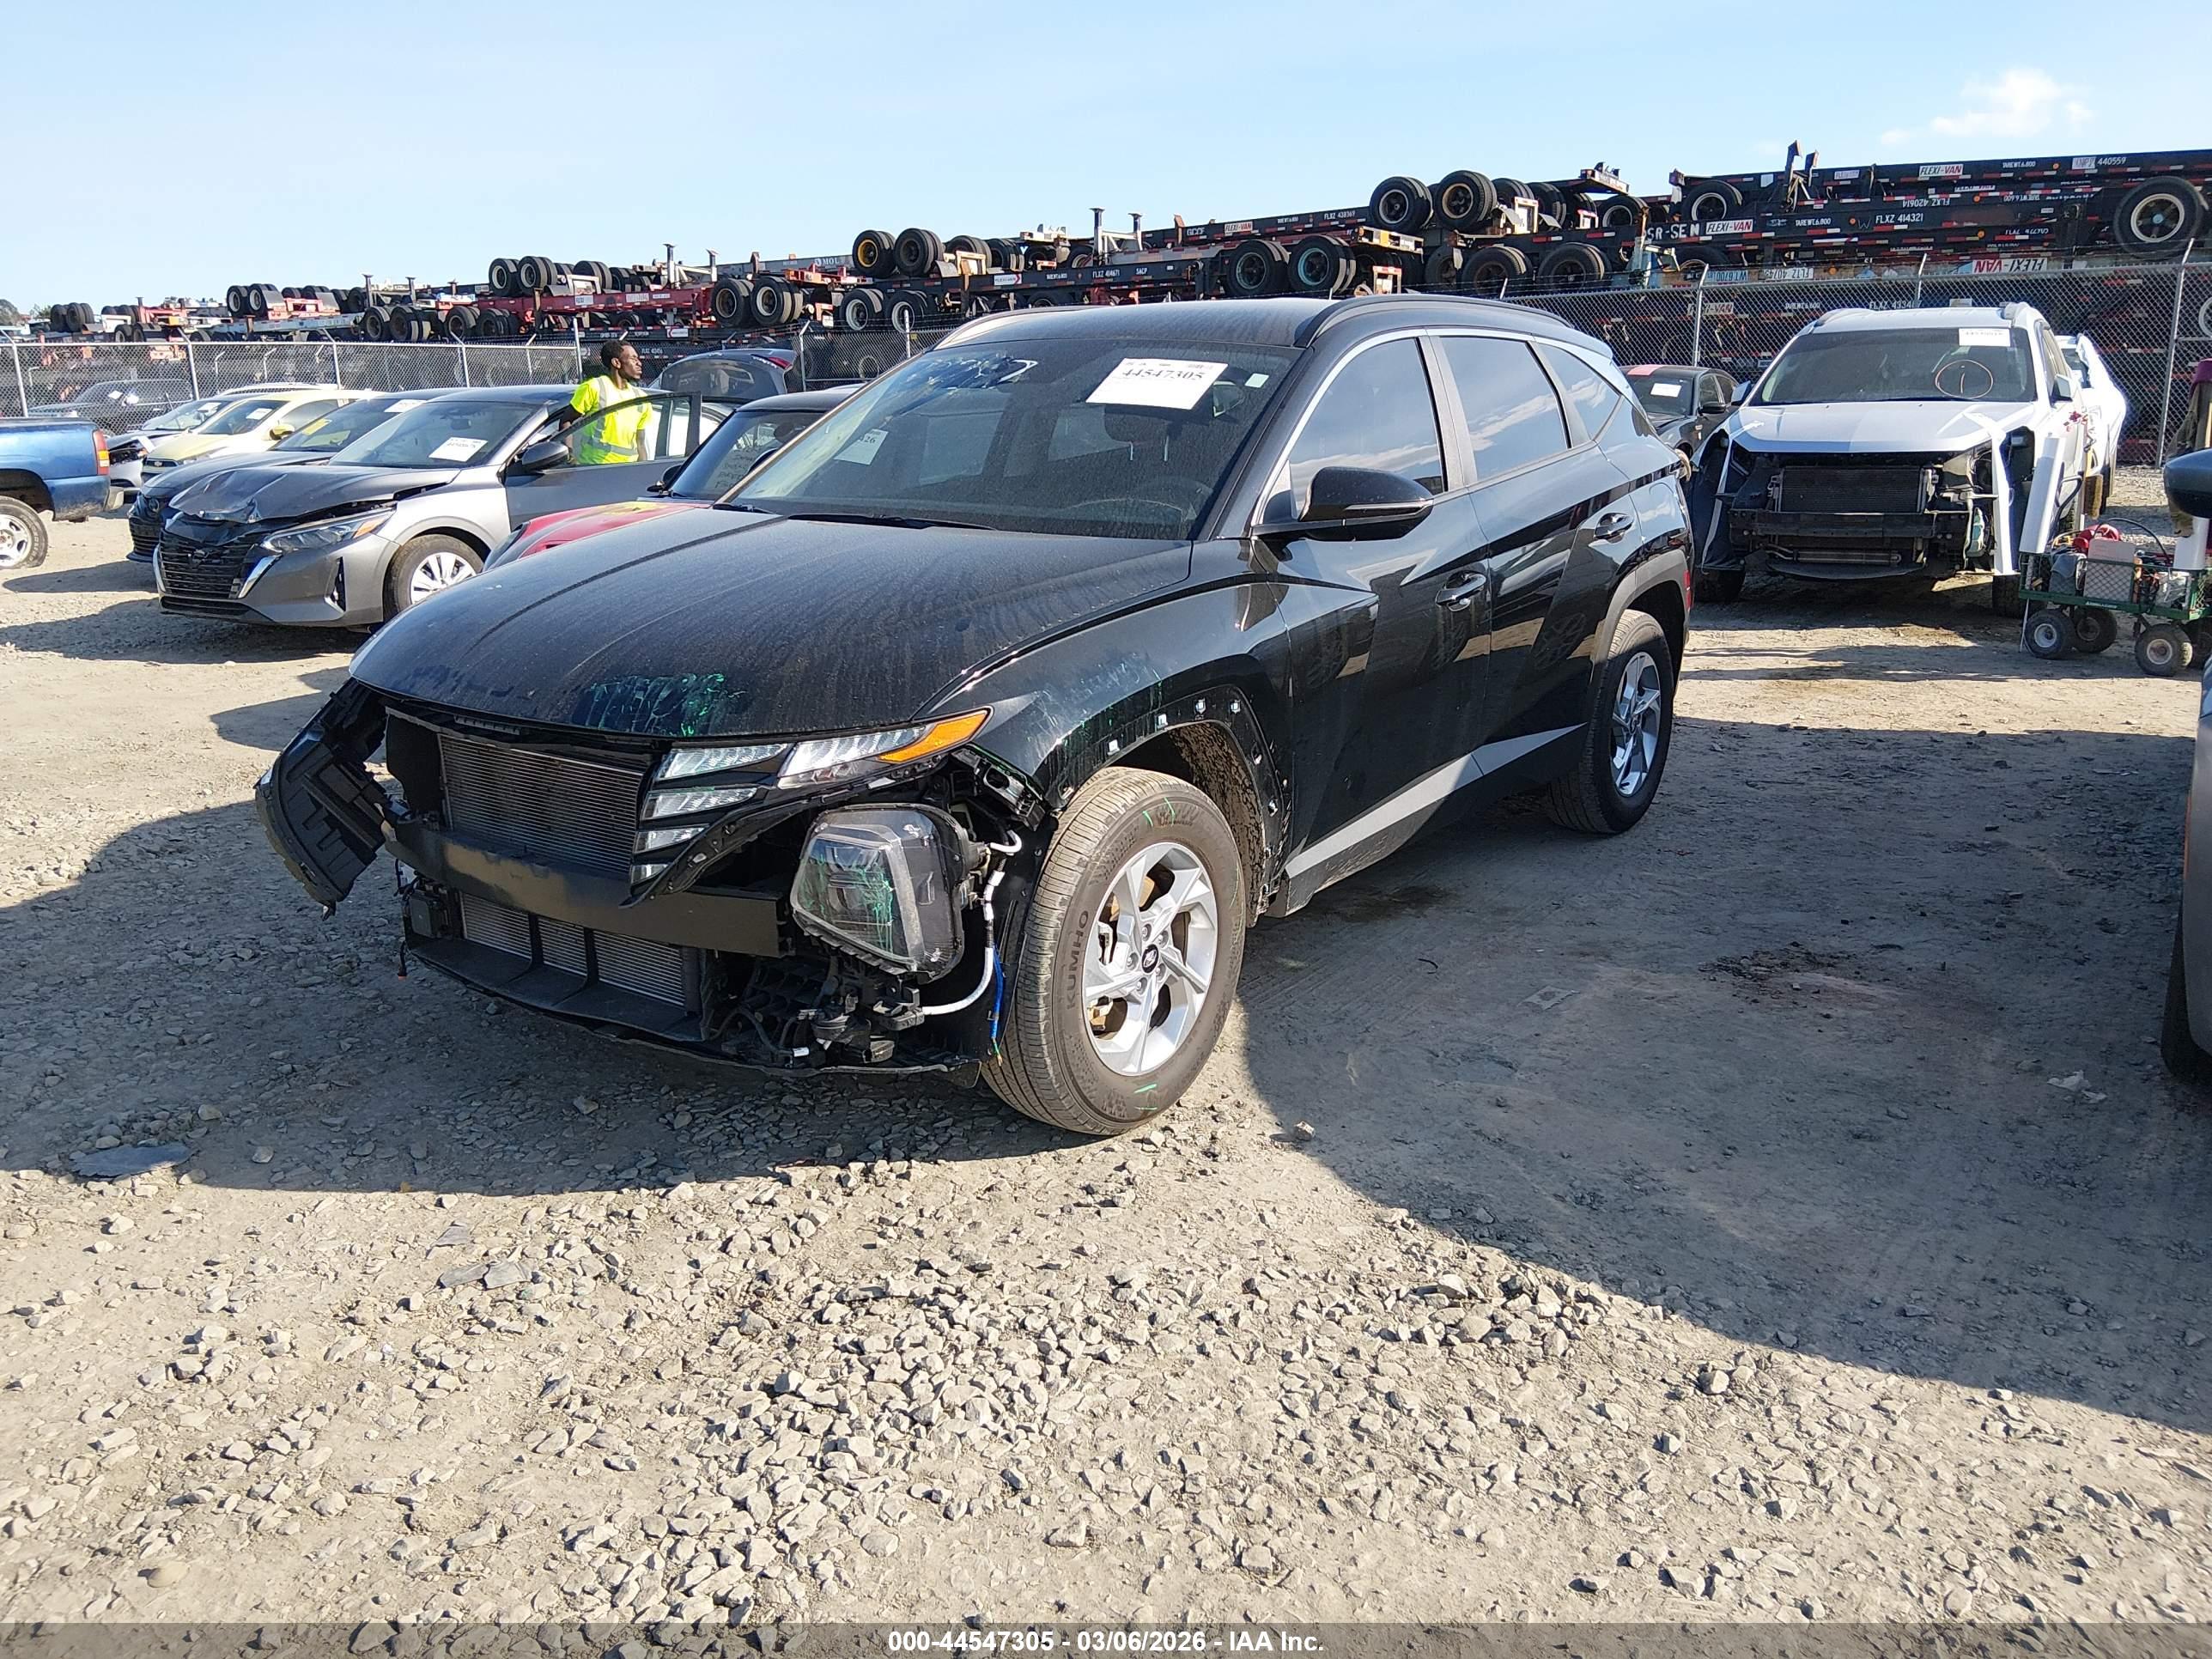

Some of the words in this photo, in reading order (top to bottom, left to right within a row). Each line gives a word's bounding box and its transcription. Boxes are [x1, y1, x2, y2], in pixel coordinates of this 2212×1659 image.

[2097, 156, 2126, 166] 440559
[1919, 165, 1961, 176] FLEXI-VAN
[1875, 215, 1894, 223] FLXZ
[1897, 212, 1923, 222] 414321
[1706, 220, 1752, 233] FLEXI-VAN
[1975, 258, 2043, 272] FLEXI-VAN
[1122, 368, 1206, 380] 44547305
[1066, 910, 1089, 1010] KUMHO
